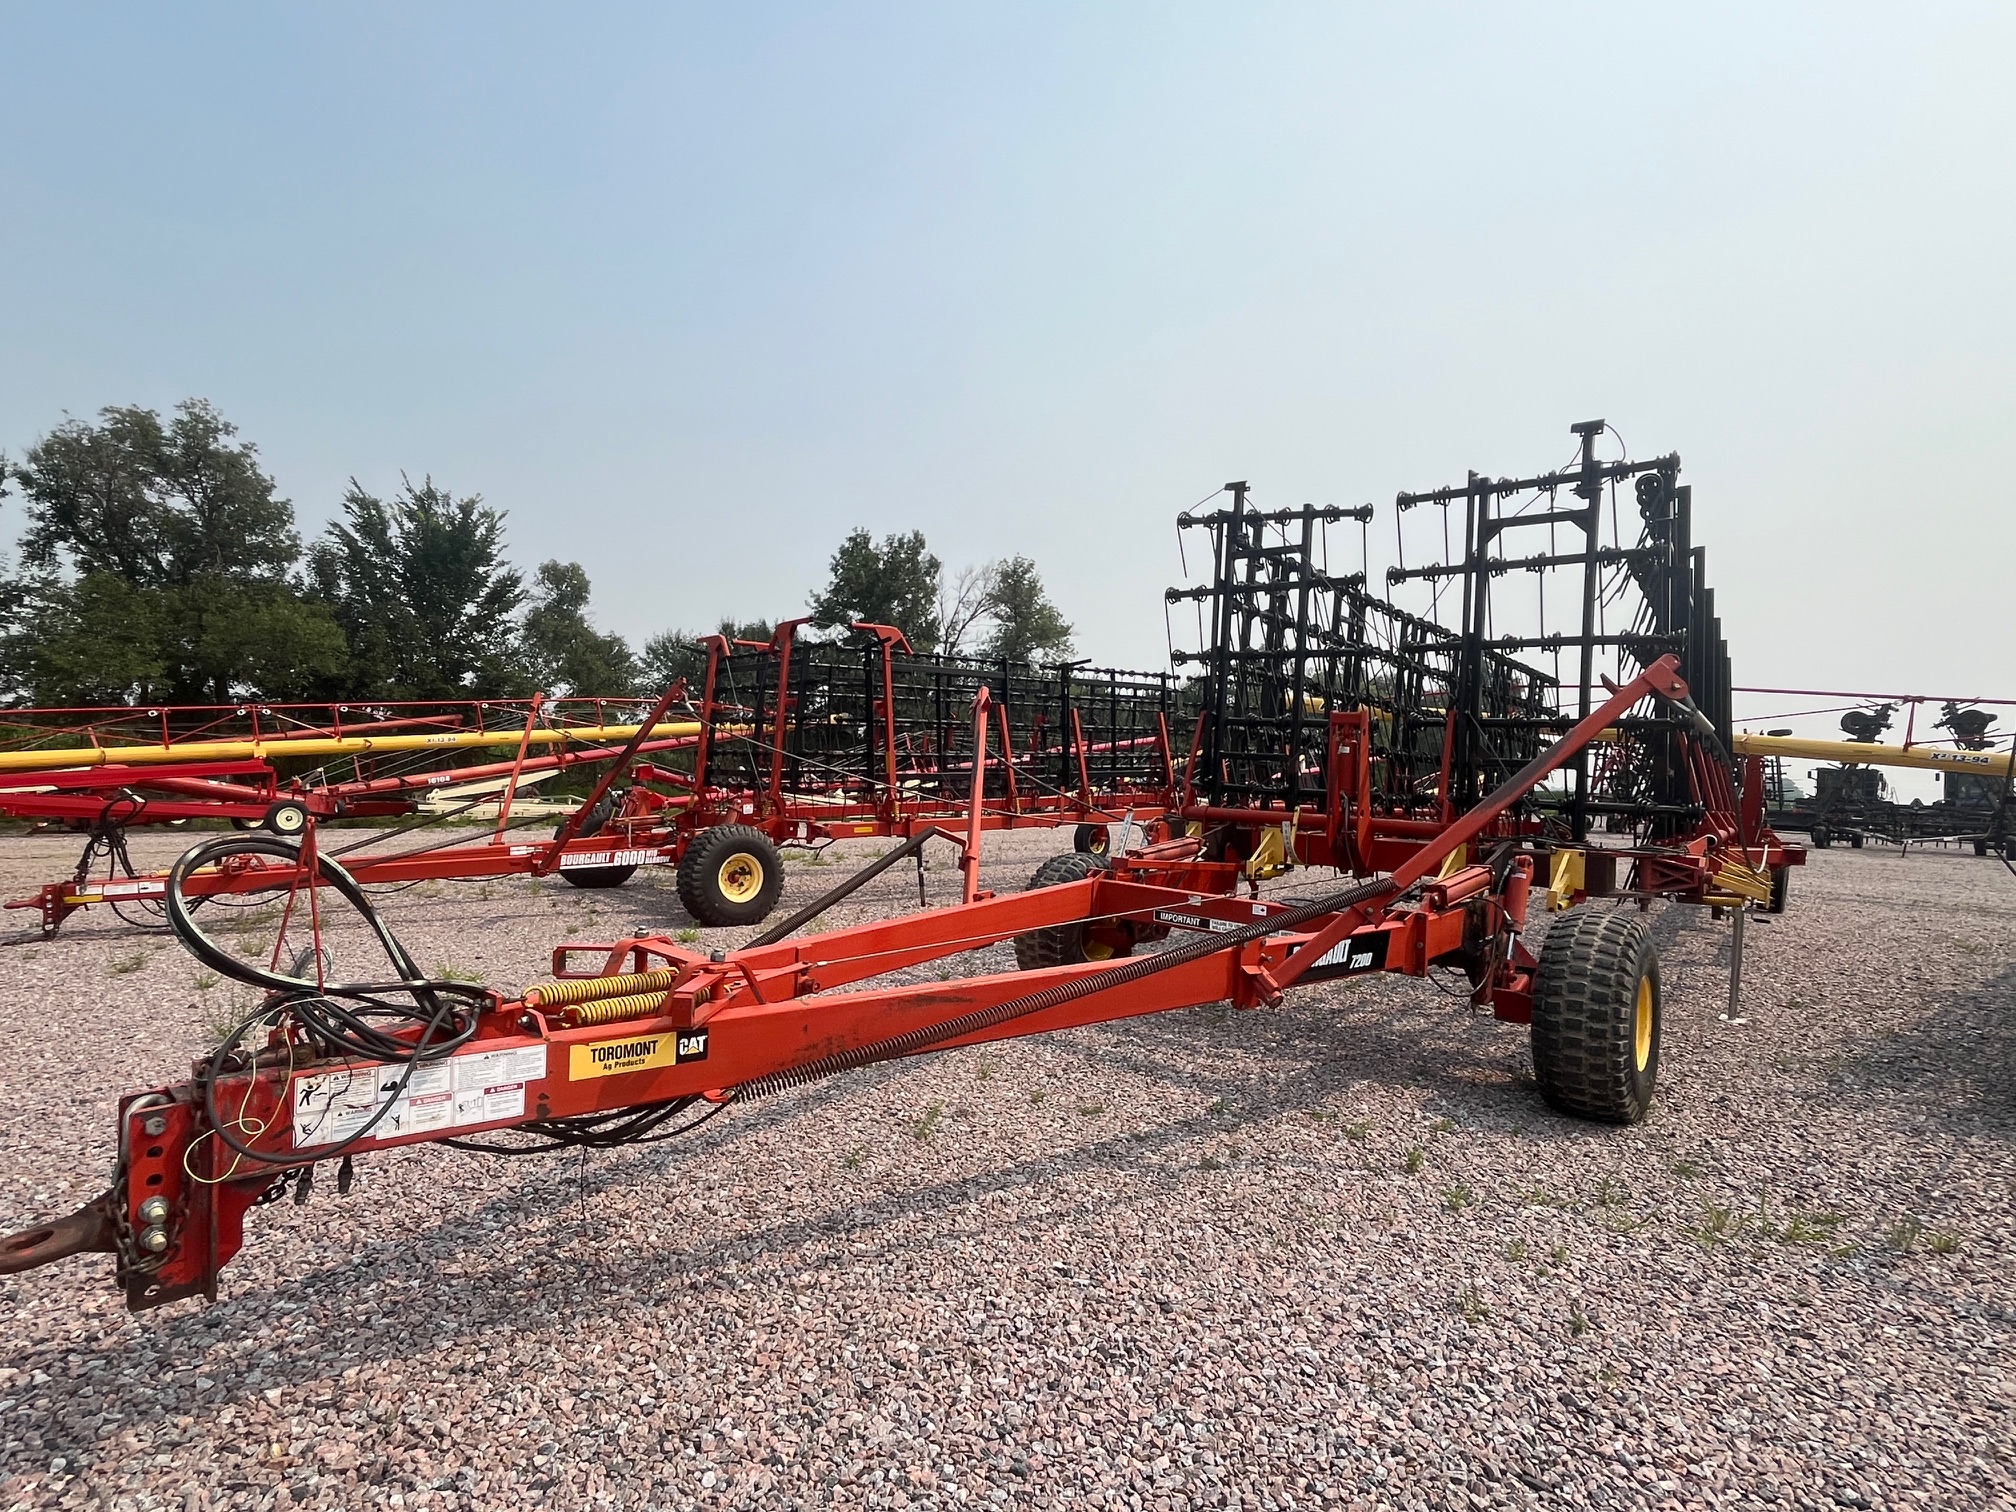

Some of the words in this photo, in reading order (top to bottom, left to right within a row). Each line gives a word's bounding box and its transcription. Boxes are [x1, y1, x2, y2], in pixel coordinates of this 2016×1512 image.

[1951, 755, 1989, 764] 13-94
[560, 852, 610, 866] BOURGAULT
[613, 850, 646, 866] 6000
[1160, 912, 1201, 926] IMPORTANT
[1349, 952, 1373, 969] 7200
[591, 1040, 658, 1063] TOROMONT
[679, 1035, 708, 1055] CAT
[603, 1062, 612, 1070] Ag
[614, 1058, 645, 1068] Products
